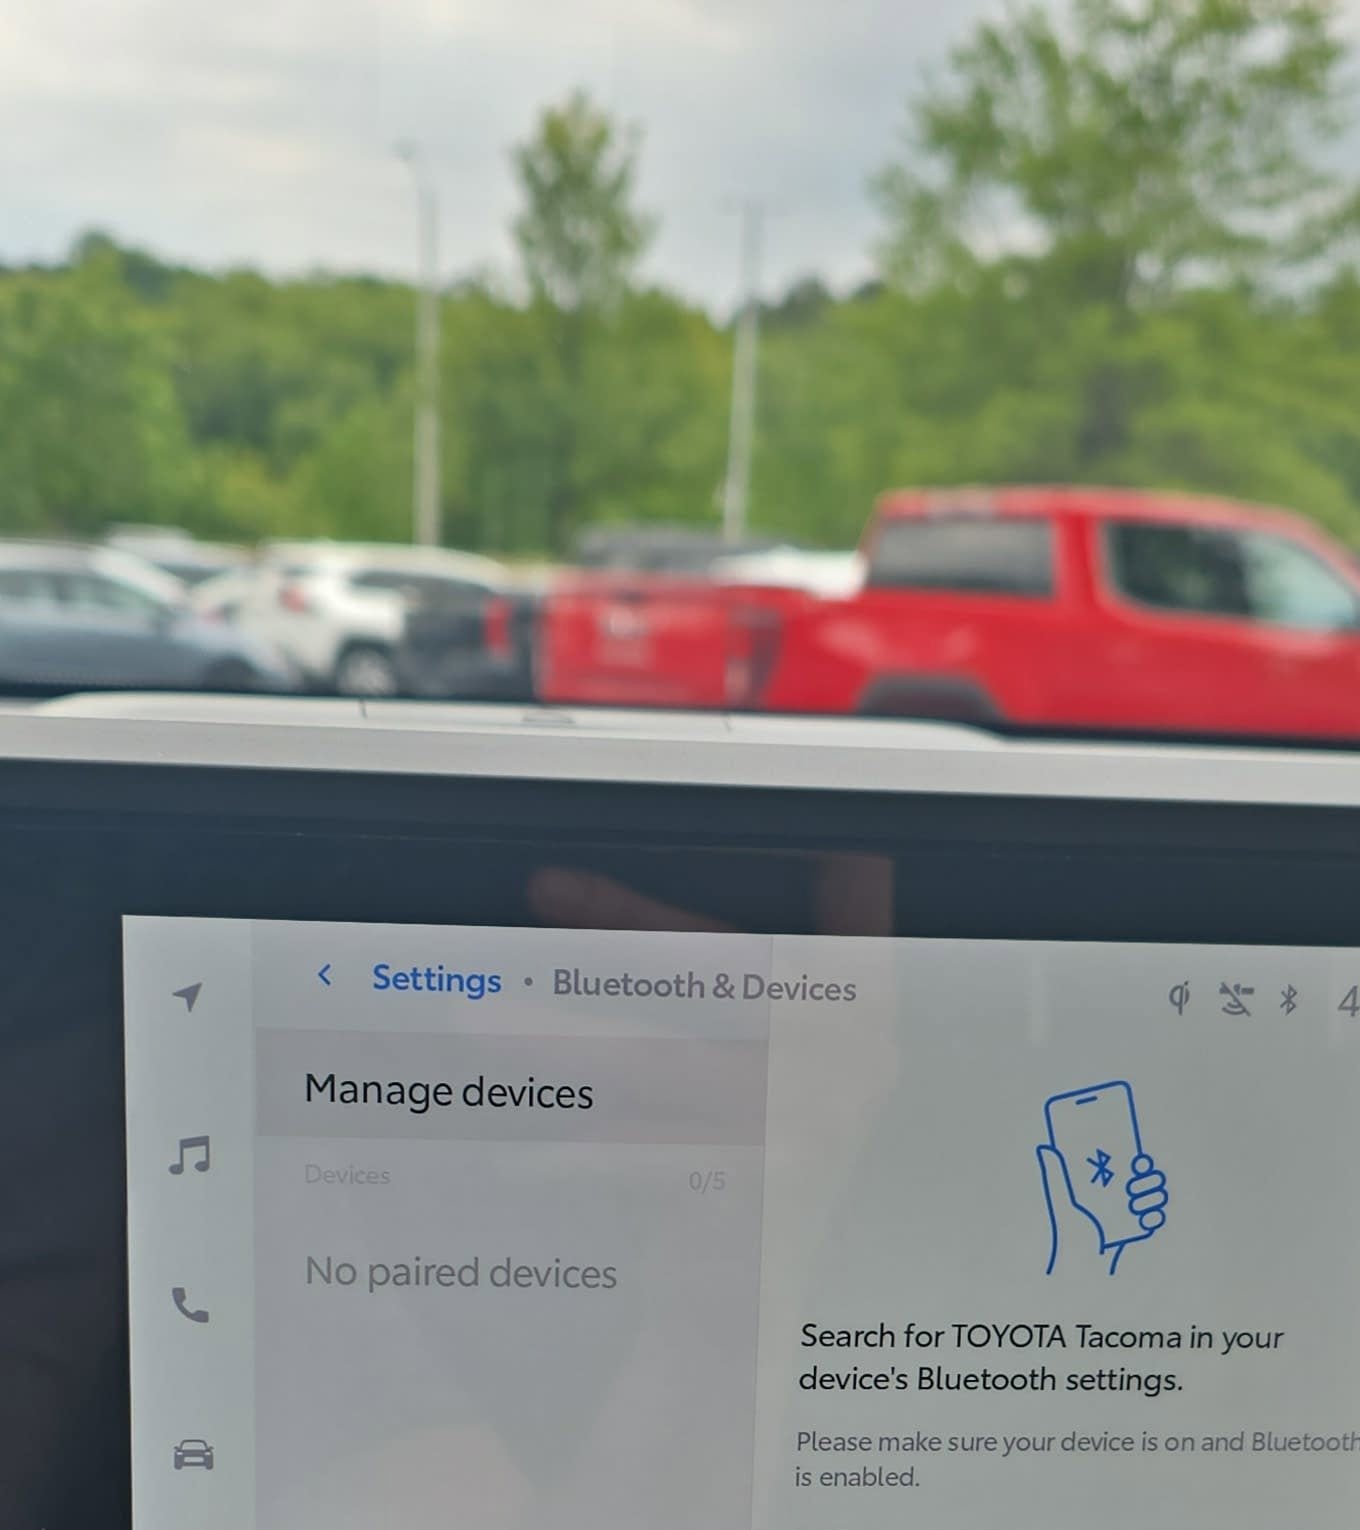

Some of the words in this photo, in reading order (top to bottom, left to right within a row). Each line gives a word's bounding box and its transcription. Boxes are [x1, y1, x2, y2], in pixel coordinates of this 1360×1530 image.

[373, 963, 503, 1002] Settings
[553, 968, 706, 1000] Bluetooth
[712, 973, 736, 1001] &
[742, 973, 858, 1003] Devices
[306, 1073, 454, 1115] Manage
[462, 1075, 594, 1111] devices
[304, 1163, 392, 1187] Devices
[688, 1166, 727, 1195] 0/5
[306, 1255, 358, 1287] No
[368, 1255, 480, 1294] paired
[489, 1255, 618, 1290] devices
[801, 1322, 896, 1349] Search
[904, 1322, 946, 1349] for
[951, 1323, 1068, 1349] TOYOTA
[1075, 1324, 1183, 1350] Tacoma
[1190, 1324, 1214, 1350] in
[1221, 1331, 1285, 1357] your
[799, 1365, 909, 1391] device's
[918, 1365, 1057, 1392] Bluetooth
[1066, 1367, 1184, 1399] settings.
[797, 1430, 874, 1453] Please
[878, 1430, 943, 1453] make
[947, 1436, 999, 1453] sure
[1002, 1436, 1057, 1459] your
[1060, 1431, 1136, 1453] device
[1141, 1430, 1159, 1453] is
[1164, 1436, 1196, 1453] on
[1201, 1431, 1246, 1453] and
[795, 1464, 813, 1488] is
[819, 1466, 921, 1488] enabled.
